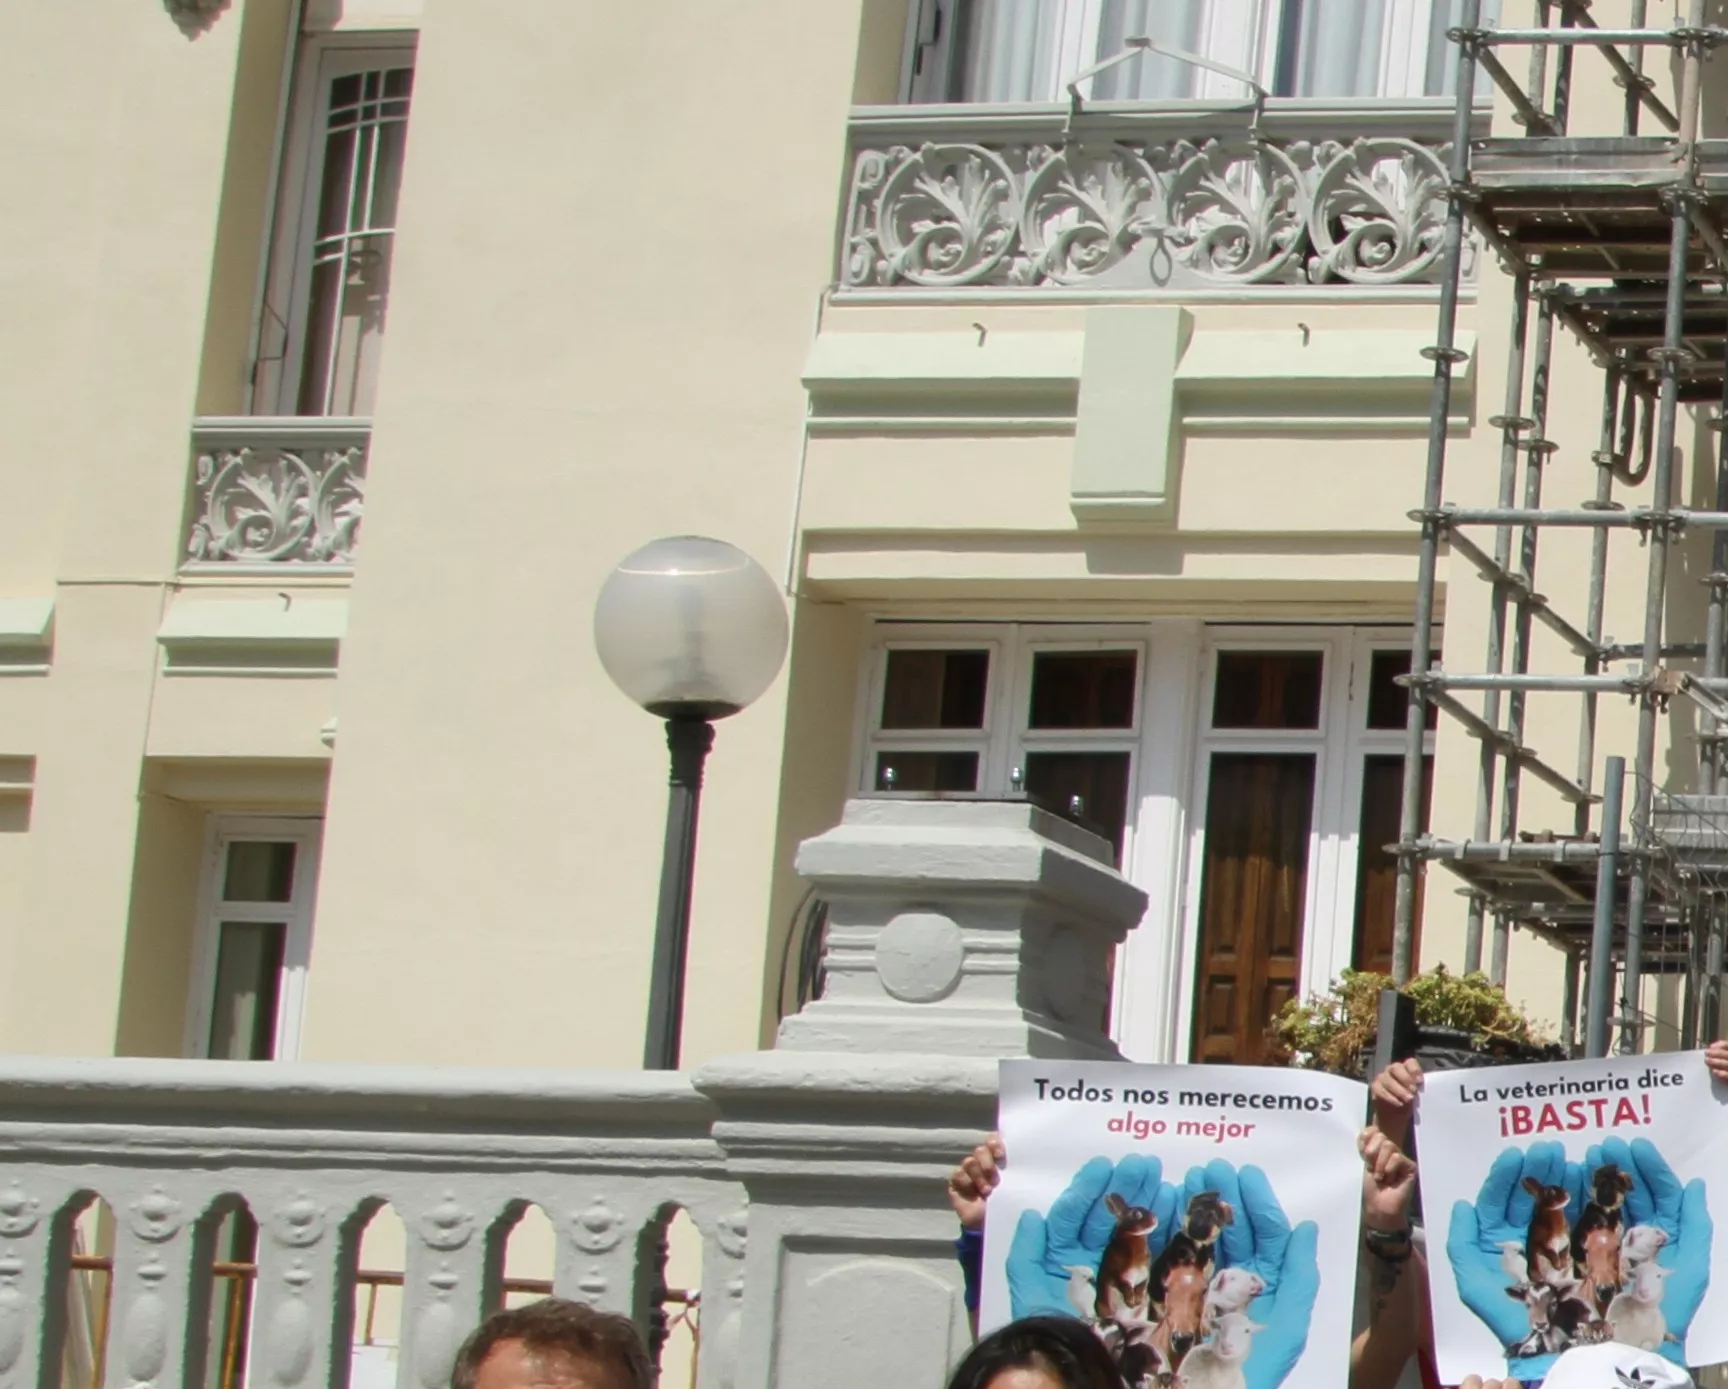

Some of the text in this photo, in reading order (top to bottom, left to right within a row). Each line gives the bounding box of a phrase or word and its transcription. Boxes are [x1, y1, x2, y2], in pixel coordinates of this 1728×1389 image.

[1034, 1078, 1334, 1112] Todos nos merecemos
[1459, 1068, 1684, 1103] La veterinaria dice
[1107, 1111, 1256, 1143] algo mejor
[1499, 1094, 1652, 1138] ¡BASTA!
